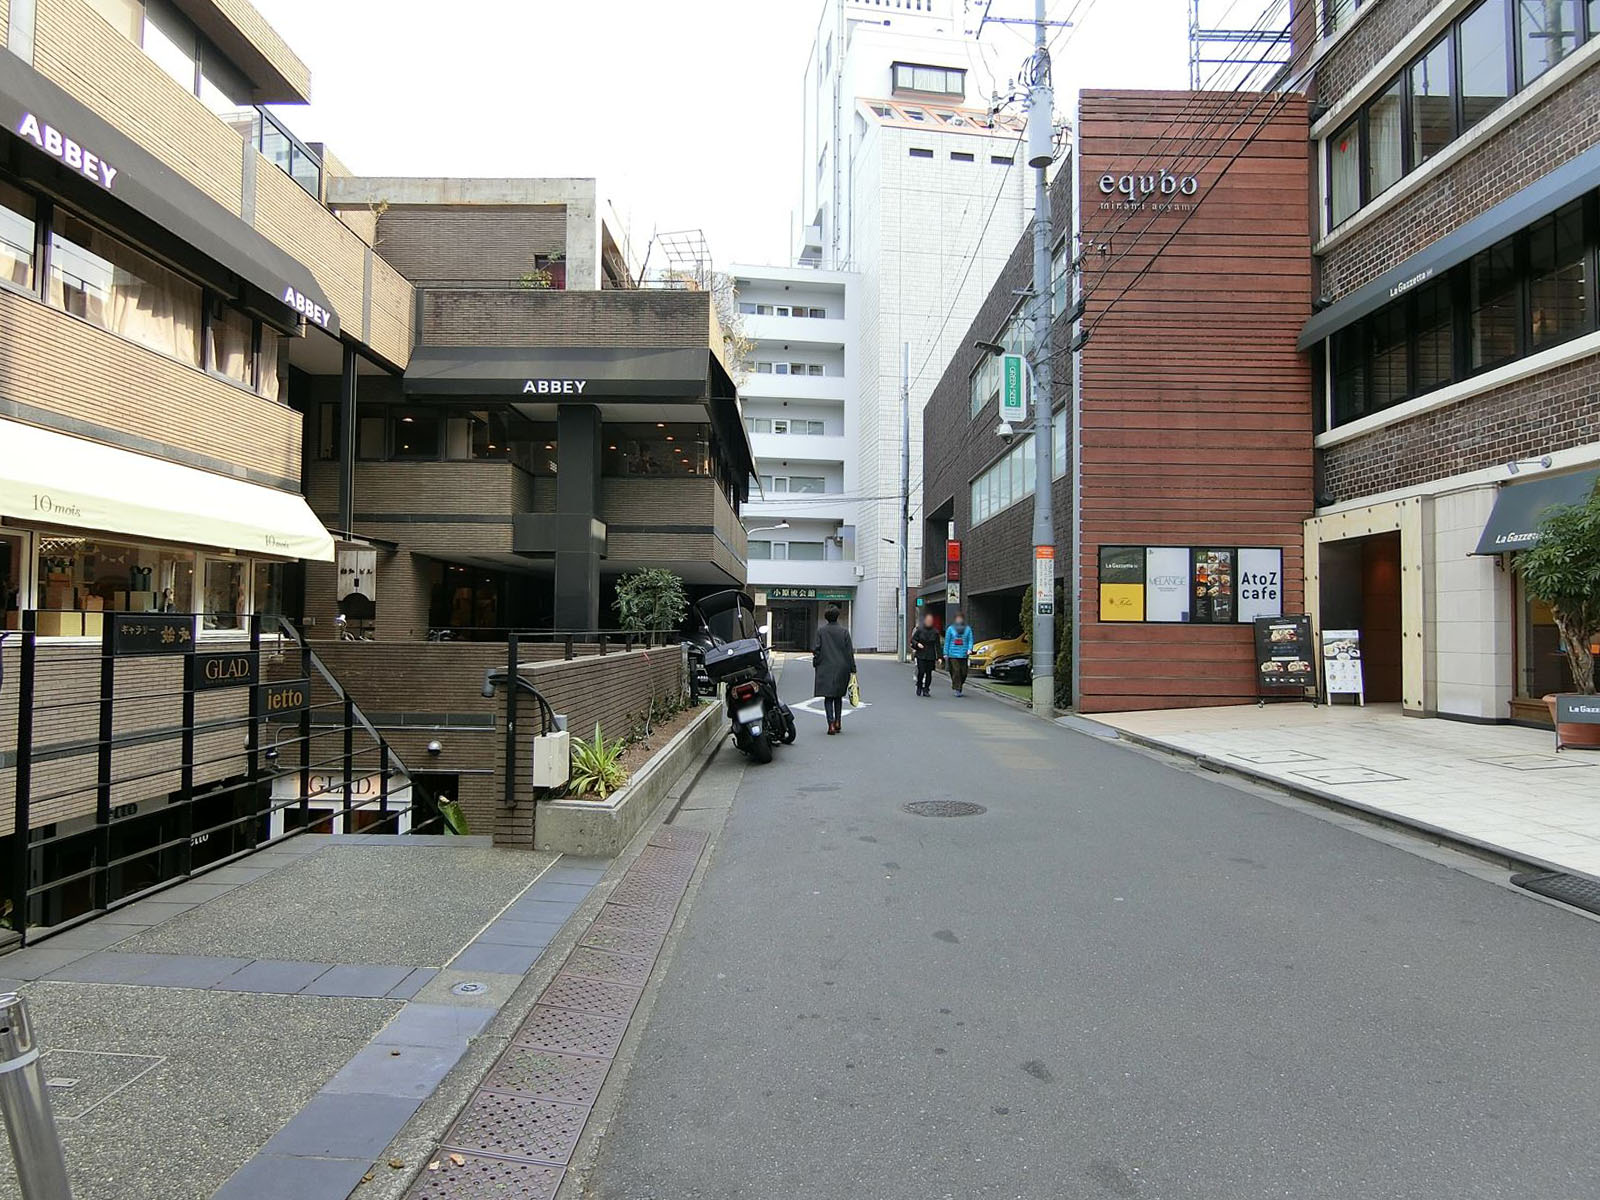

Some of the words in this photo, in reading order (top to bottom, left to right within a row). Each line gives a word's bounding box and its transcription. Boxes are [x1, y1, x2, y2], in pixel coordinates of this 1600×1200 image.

[18, 112, 117, 189] ABBEY
[1099, 169, 1198, 200] equbo
[1390, 288, 1398, 297] La
[283, 286, 331, 328] ABBEY
[523, 380, 587, 394] ABBEY
[32, 494, 52, 513] 10
[54, 504, 81, 517] mois
[265, 534, 276, 547] 10
[1495, 534, 1507, 544] La
[1242, 586, 1277, 600] cafe
[267, 688, 303, 710] ietto
[1569, 705, 1580, 713] La
